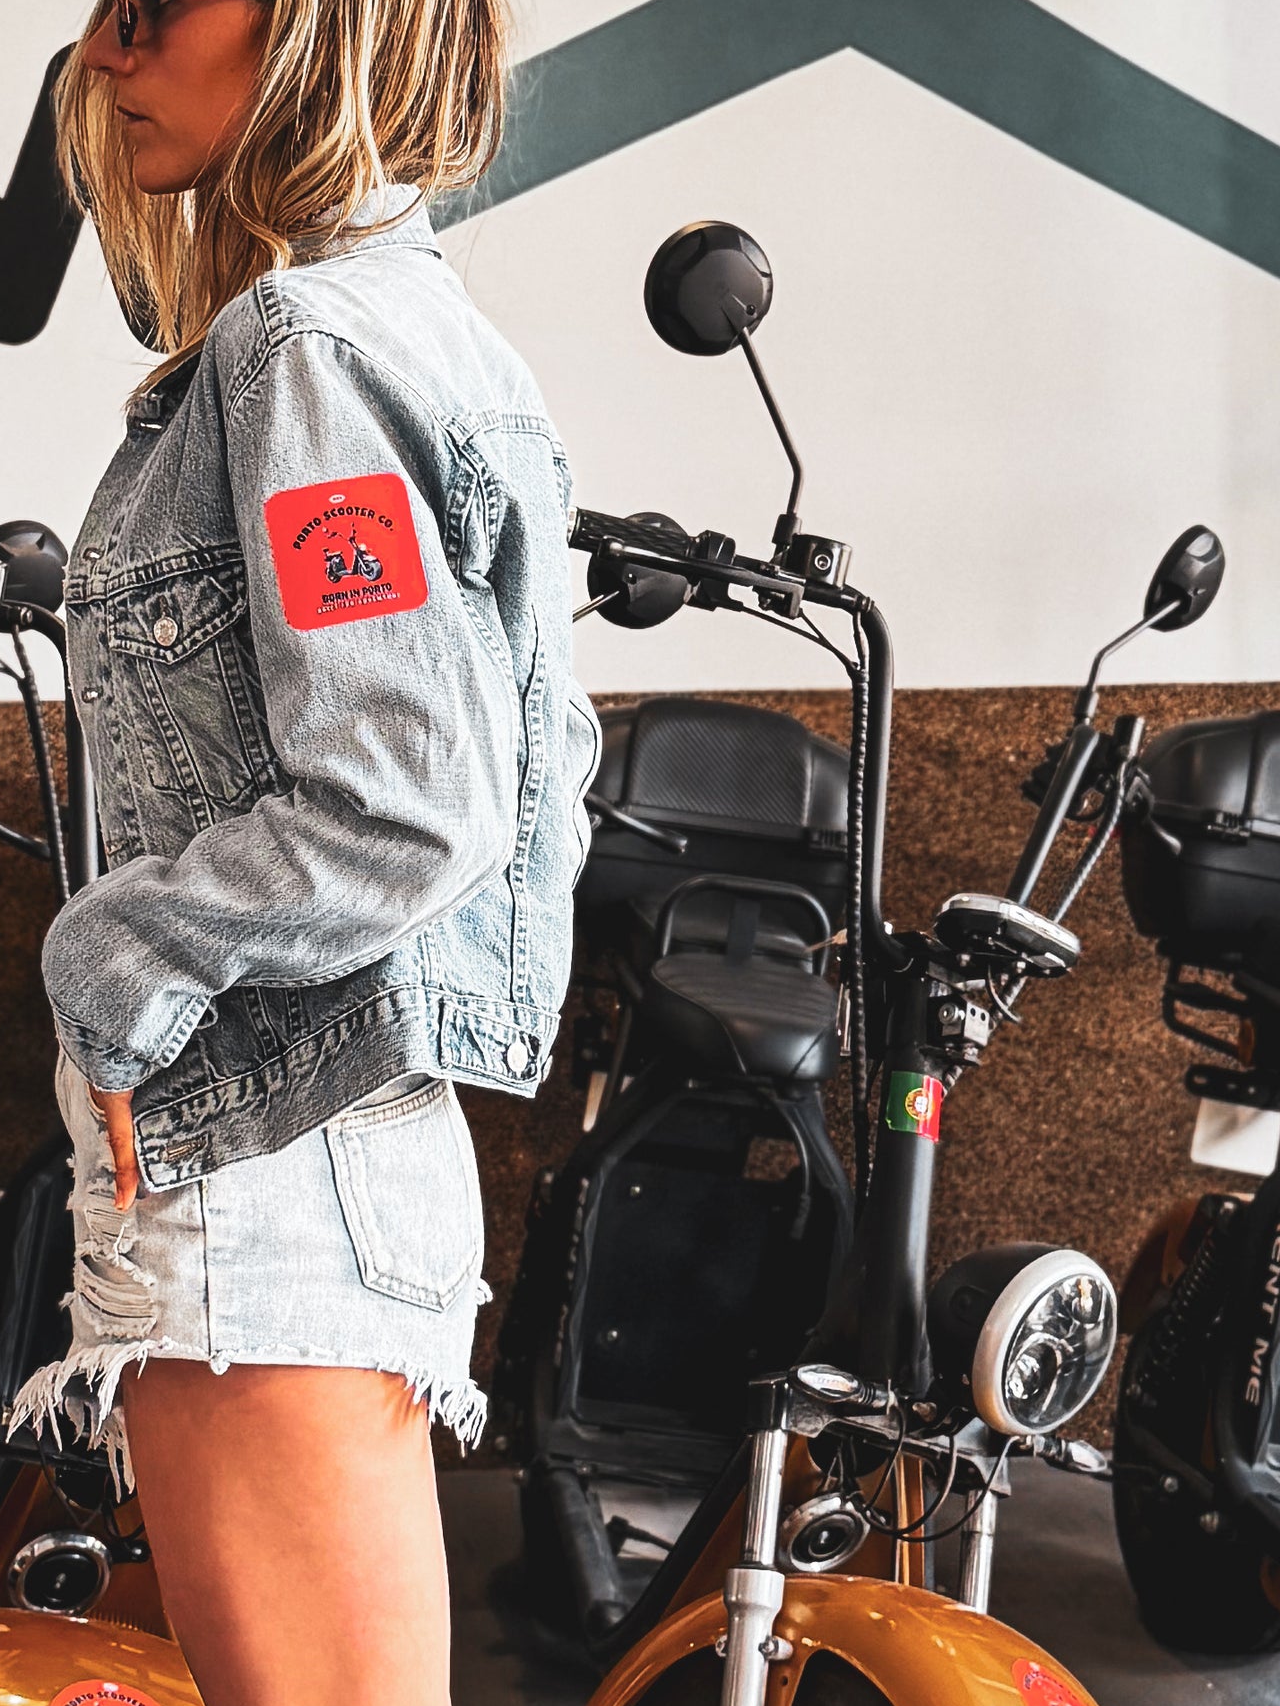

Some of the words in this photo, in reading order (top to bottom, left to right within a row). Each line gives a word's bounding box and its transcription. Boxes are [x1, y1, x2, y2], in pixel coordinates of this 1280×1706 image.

[292, 516, 322, 550] PORTO
[322, 505, 376, 522] SCOOTER
[378, 514, 394, 532] CO.
[321, 591, 349, 604] BORN
[349, 588, 361, 599] IN
[361, 582, 393, 596] PORTO
[1244, 1337, 1270, 1407] ME
